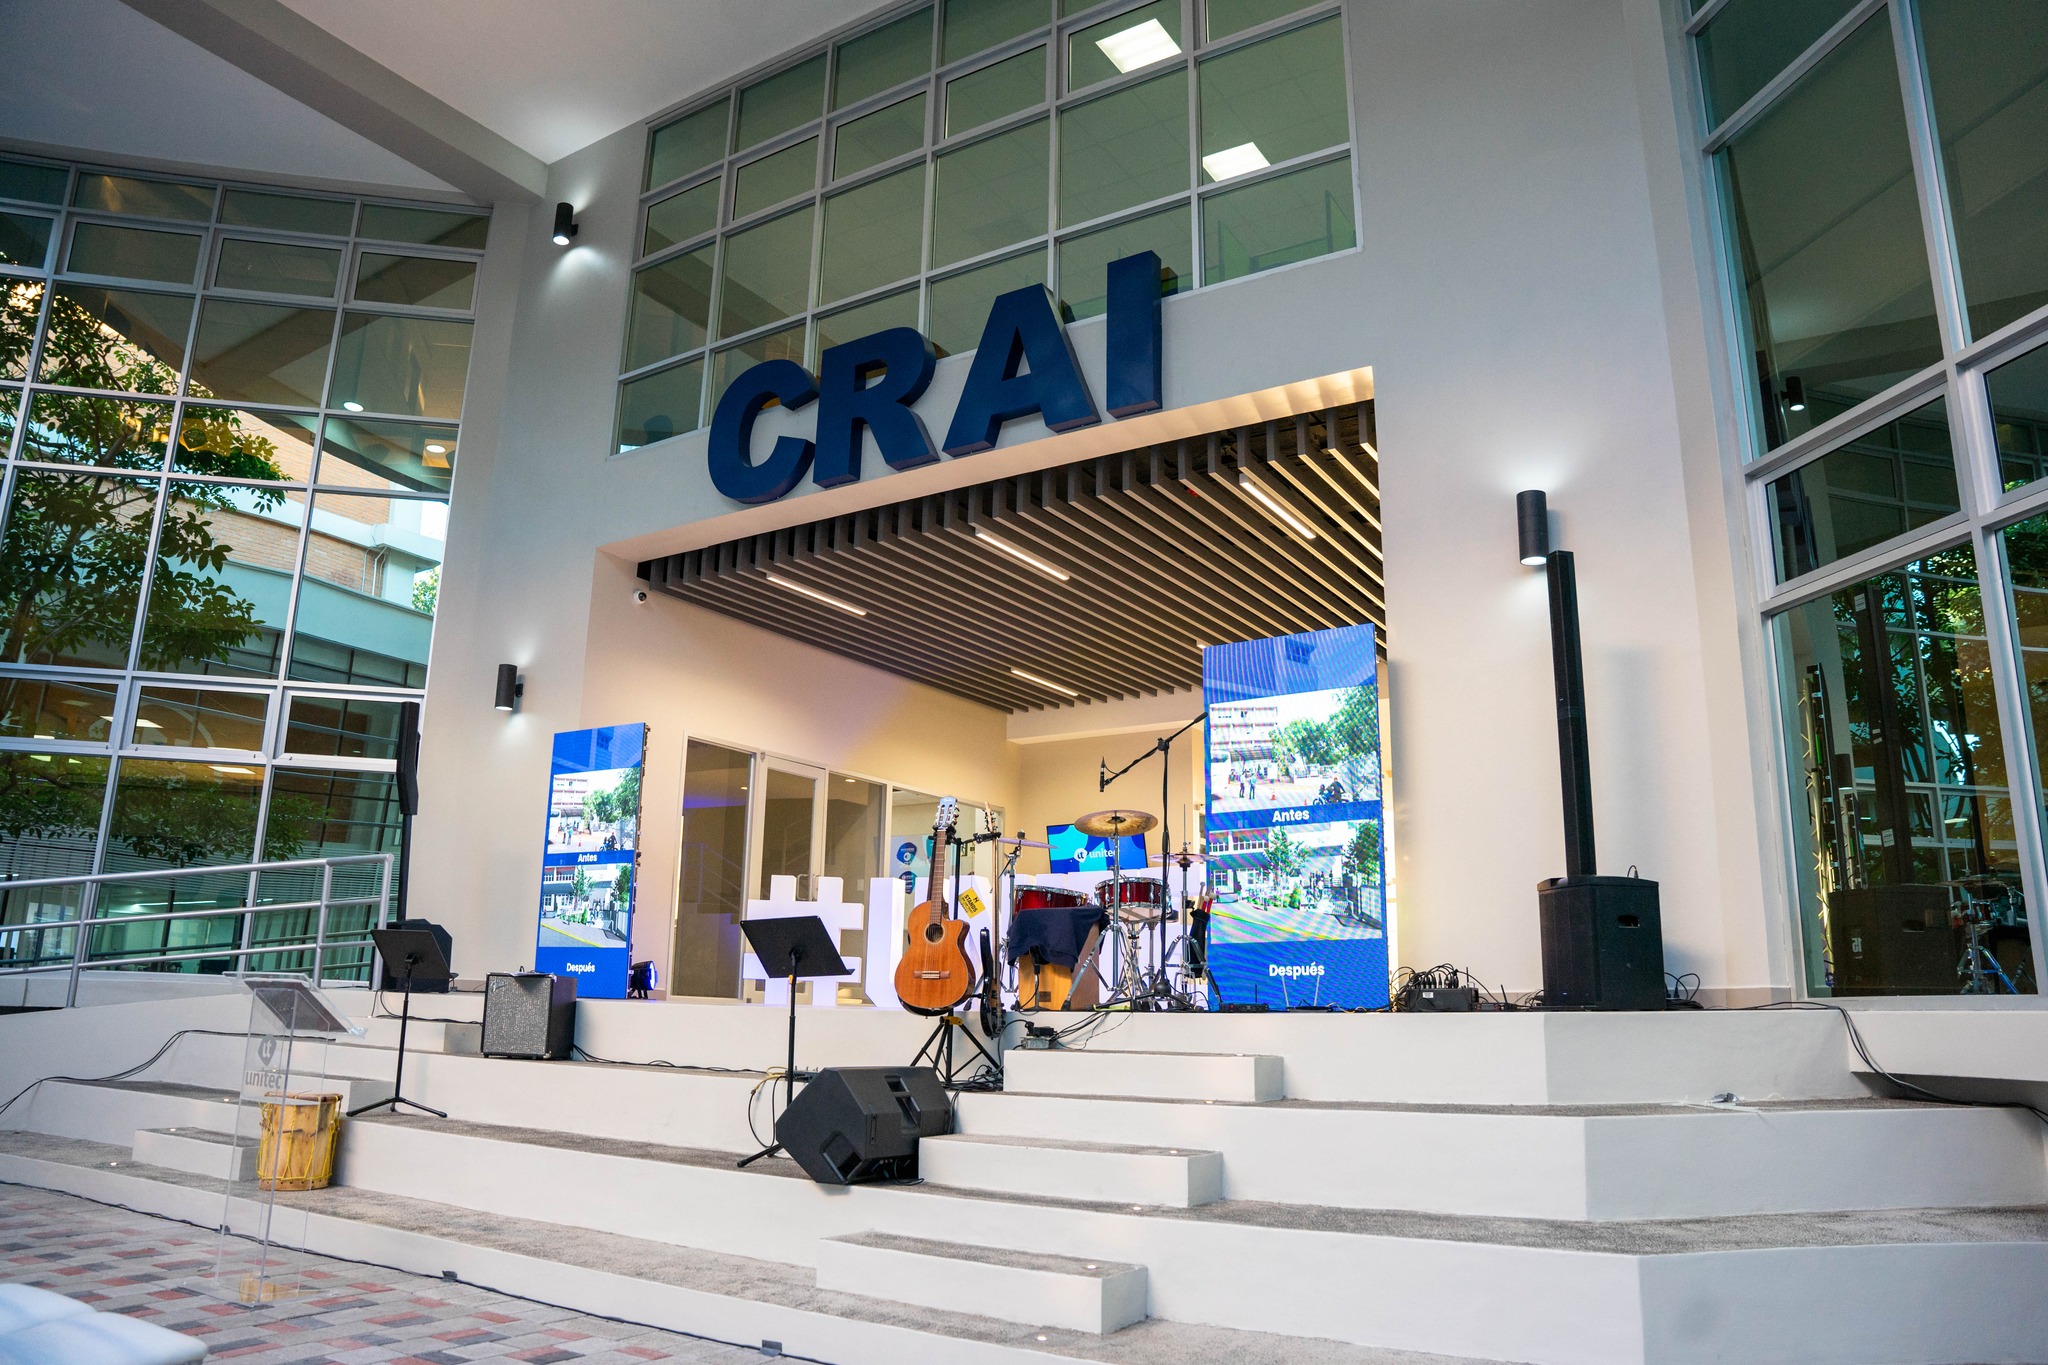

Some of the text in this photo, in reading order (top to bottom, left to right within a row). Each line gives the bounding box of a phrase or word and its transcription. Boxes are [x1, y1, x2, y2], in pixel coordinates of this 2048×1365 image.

[707, 249, 1163, 504] CRAI
[1272, 810, 1310, 823] Antes
[577, 854, 598, 863] Antes
[566, 962, 595, 974] Después
[1269, 962, 1325, 980] Después
[245, 1067, 282, 1090] unitec
